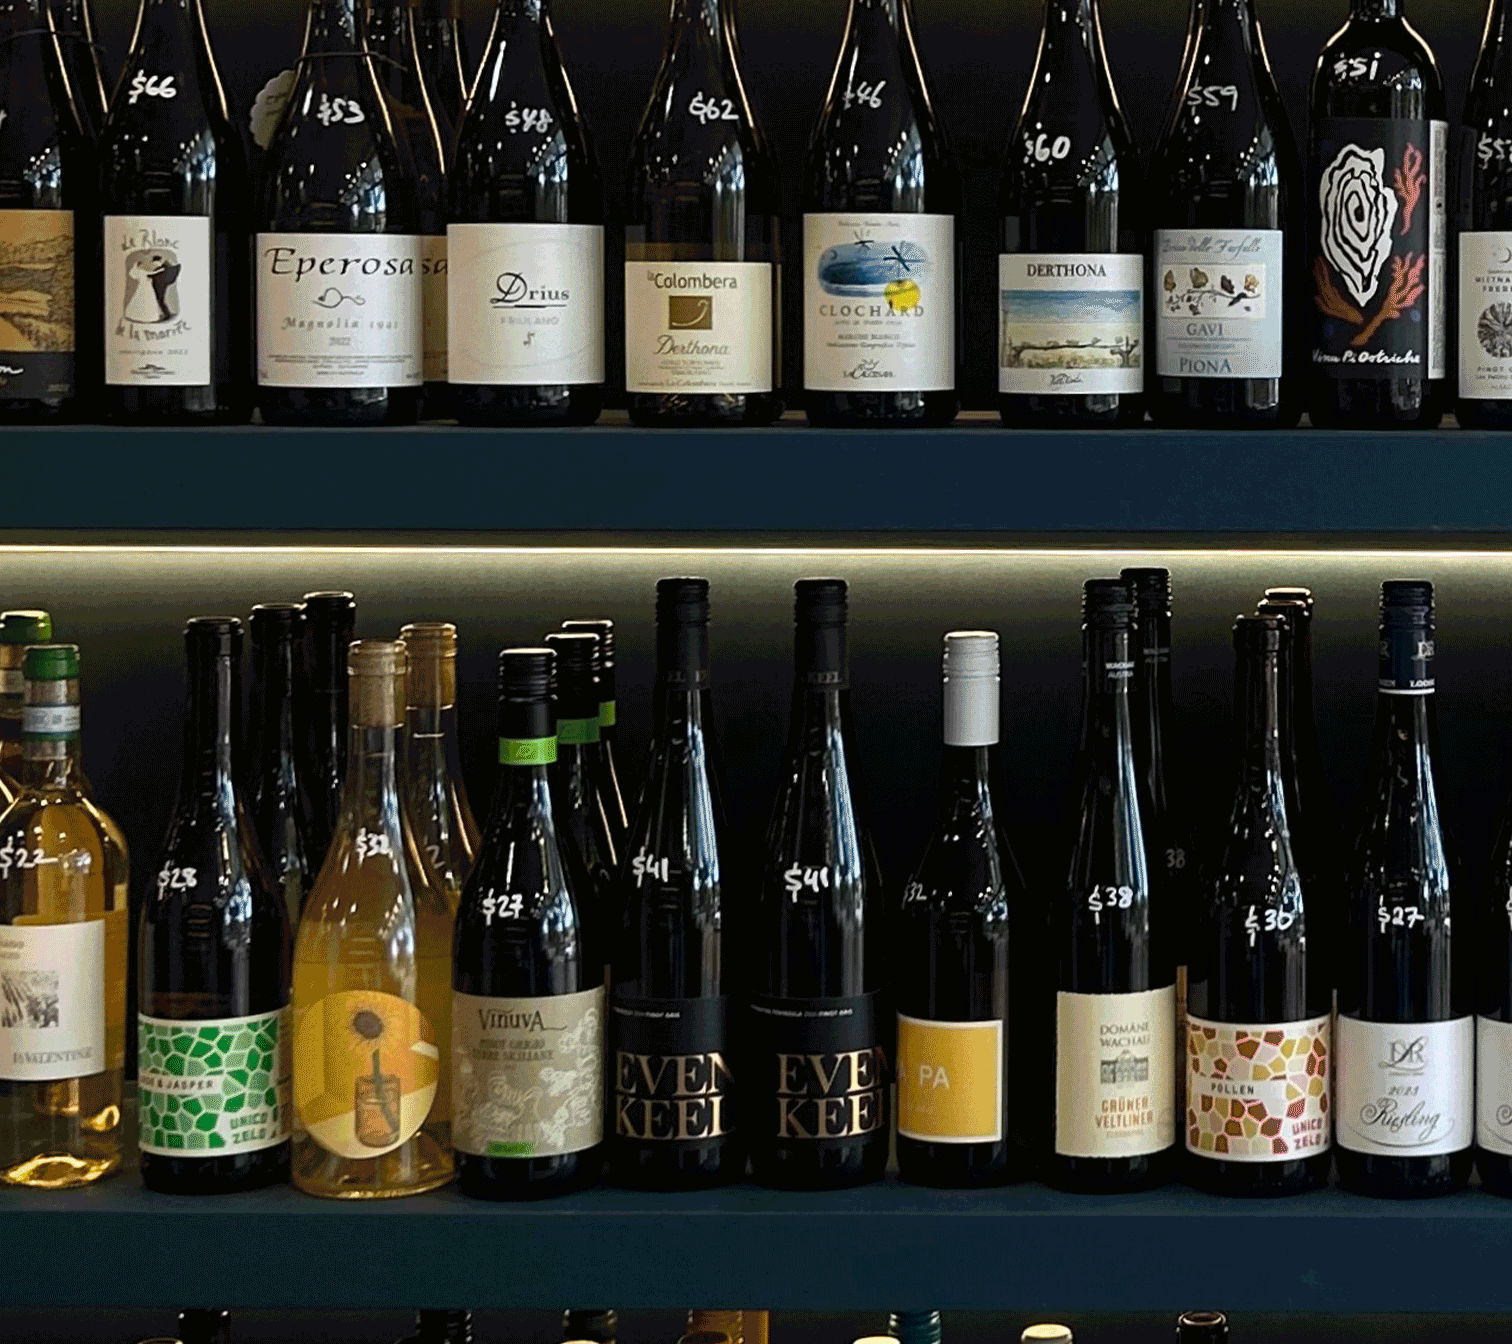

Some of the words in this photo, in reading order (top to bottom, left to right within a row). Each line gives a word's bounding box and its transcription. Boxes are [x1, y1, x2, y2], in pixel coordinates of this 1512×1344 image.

[128, 69, 177, 104] $66
[1187, 81, 1239, 116] $59
[316, 93, 365, 127] $53
[689, 91, 739, 123] $62
[1025, 133, 1070, 165] $60
[264, 246, 415, 282] Eperosa
[654, 273, 738, 289] Colombera
[1027, 264, 1107, 277] DERTHONA
[490, 272, 570, 305] Drius
[819, 304, 924, 318] CLOCHARD
[652, 334, 729, 355] Derthona
[1186, 323, 1223, 336] GAVI
[157, 860, 197, 900] $28
[632, 847, 669, 888] $41
[784, 861, 830, 904] $41
[482, 888, 525, 927] $27
[1088, 884, 1134, 925] $38
[1377, 895, 1425, 934] $27
[1244, 905, 1294, 947] $36
[176, 1079, 213, 1090] JASPER
[1211, 1083, 1254, 1095] POLLEN
[1095, 1110, 1153, 1129] VELTLINER
[1360, 1098, 1441, 1140] Riesling
